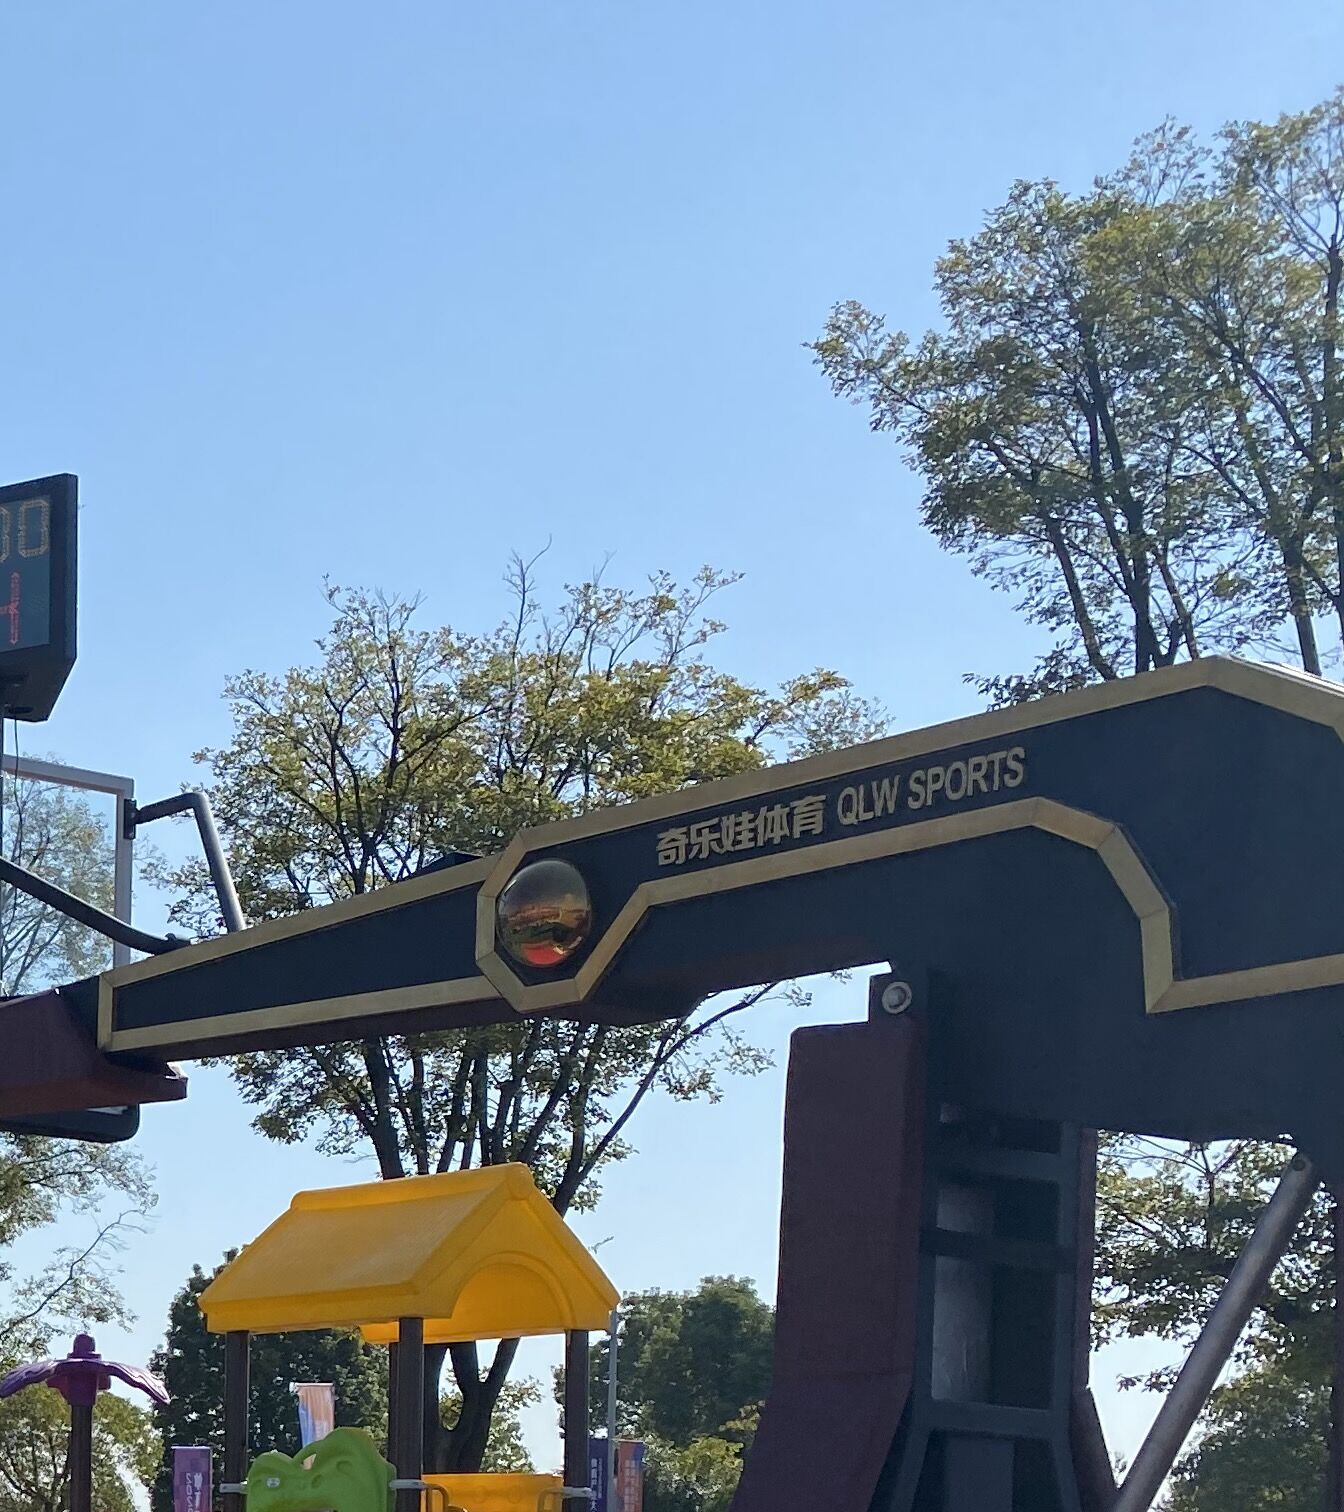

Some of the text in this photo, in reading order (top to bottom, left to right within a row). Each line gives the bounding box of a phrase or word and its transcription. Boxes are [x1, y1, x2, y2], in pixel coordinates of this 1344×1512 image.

[836, 746, 1026, 826] QLW SPORTS
[656, 794, 827, 866] 奇乐娃体育
